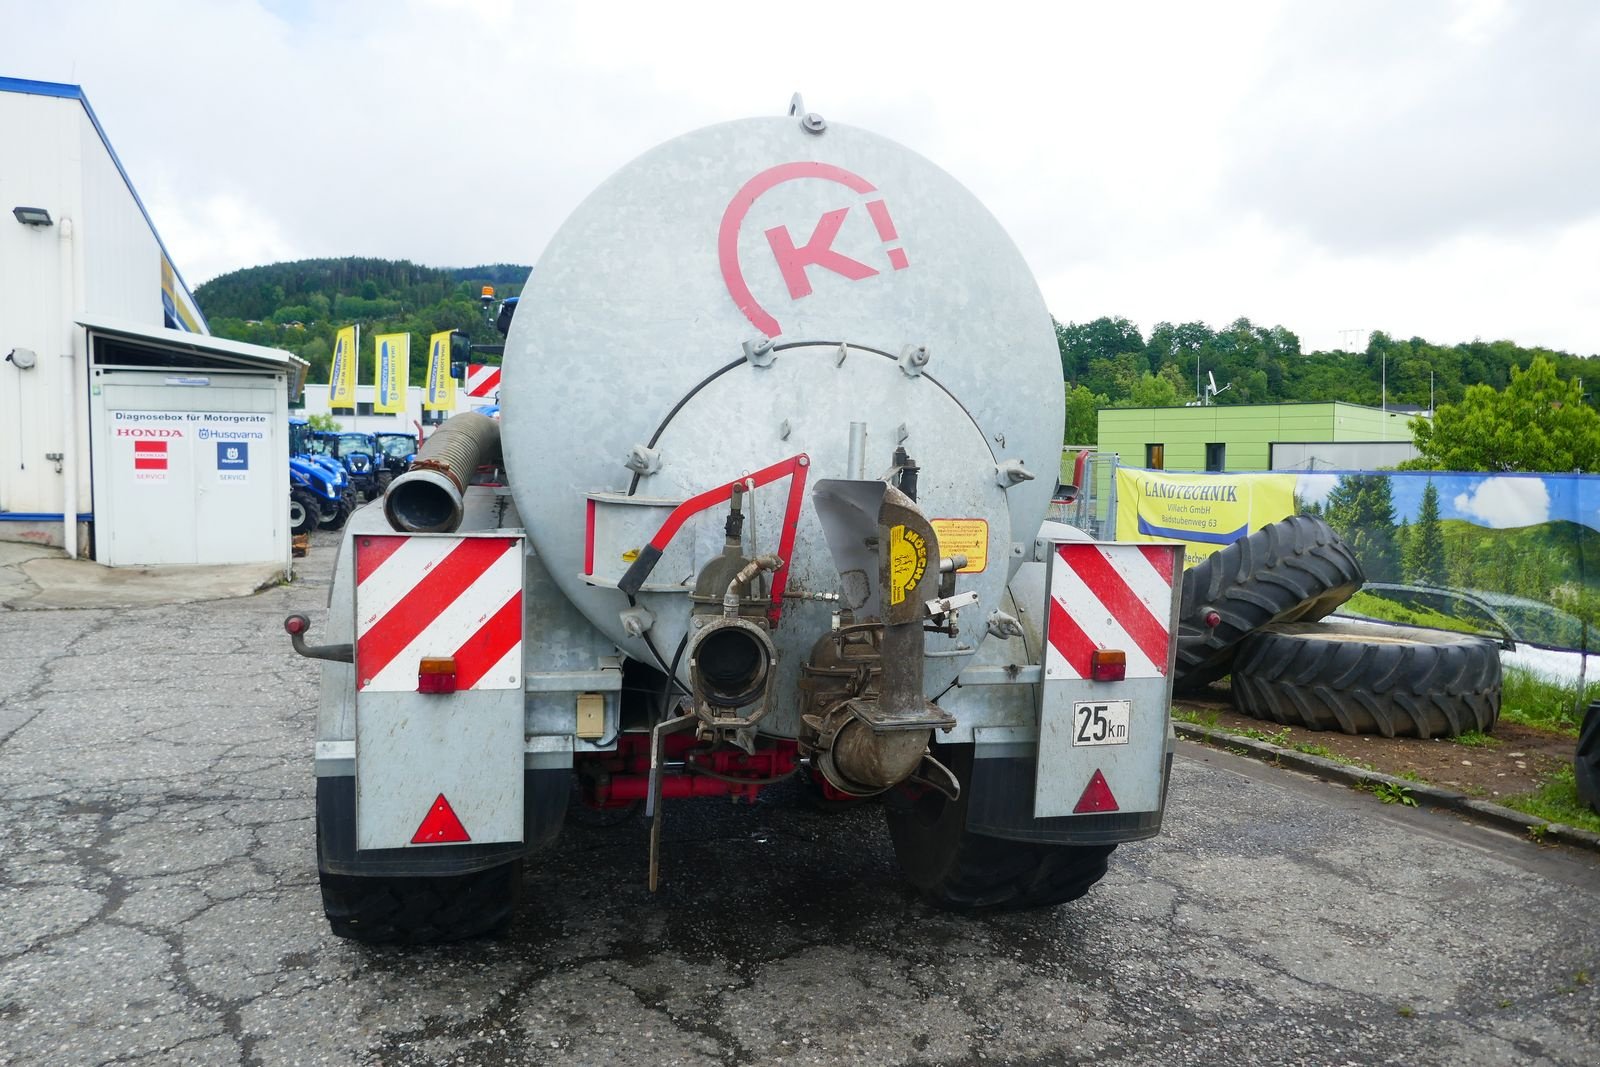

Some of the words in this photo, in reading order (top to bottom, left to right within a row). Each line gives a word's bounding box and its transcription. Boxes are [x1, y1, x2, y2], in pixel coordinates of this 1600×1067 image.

[115, 412, 183, 422] Diagnosebox
[204, 414, 266, 424] Motorgeräte
[117, 428, 184, 437] HONDA
[210, 430, 263, 439] Husqvarna
[1145, 482, 1237, 502] LANDTECHNIK
[1168, 503, 1188, 513] Villach
[1189, 505, 1211, 514] GmbH
[1162, 515, 1207, 528] Badstubenweg
[1208, 519, 1217, 527] 63
